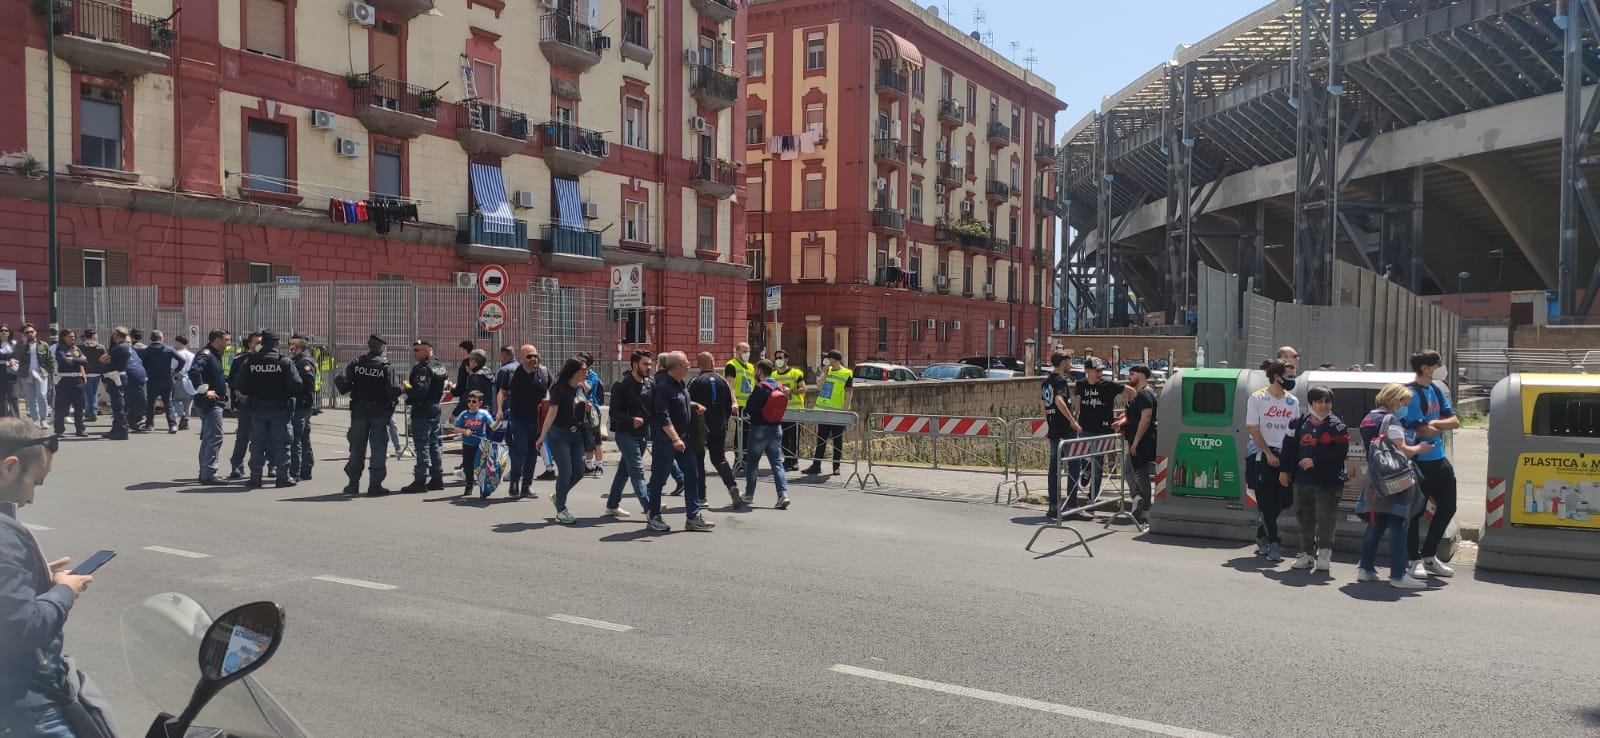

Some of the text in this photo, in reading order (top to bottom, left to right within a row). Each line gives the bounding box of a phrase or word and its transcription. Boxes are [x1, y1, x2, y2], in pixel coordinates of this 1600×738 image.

[250, 364, 282, 373] POLIZIA
[354, 366, 384, 378] POLIZIA
[1264, 405, 1292, 418] Lete
[1190, 437, 1223, 447] VETRO
[1523, 456, 1579, 468] PLASTICA
